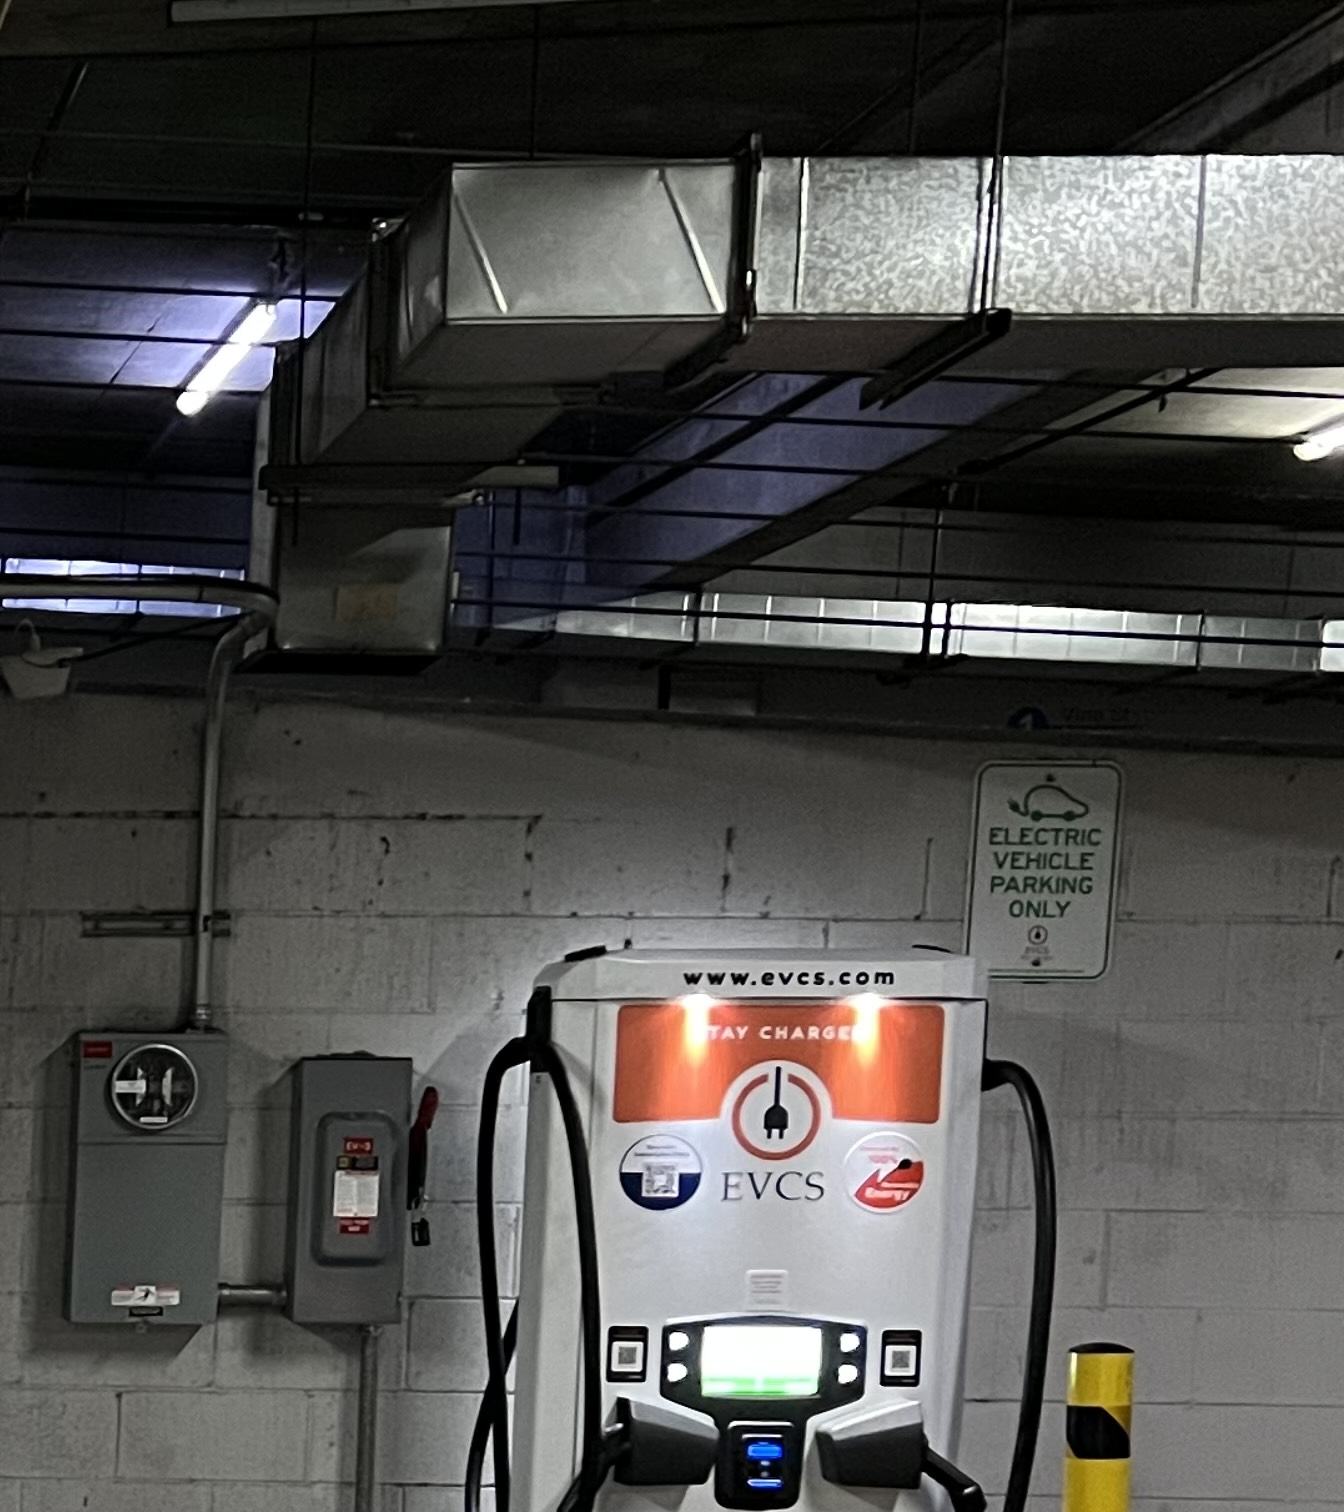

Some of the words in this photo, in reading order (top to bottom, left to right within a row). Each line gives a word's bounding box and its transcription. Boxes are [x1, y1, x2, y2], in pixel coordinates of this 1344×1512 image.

[988, 826, 1103, 847] ELECTRIC
[993, 851, 1095, 871] VEHICLE
[990, 875, 1094, 895] PARKING
[1008, 900, 1071, 919] ONLY
[682, 969, 895, 986] www.evcs.com
[699, 1024, 749, 1041] TAY
[758, 1025, 864, 1041] CHARGE
[720, 1170, 825, 1202] EVCS
